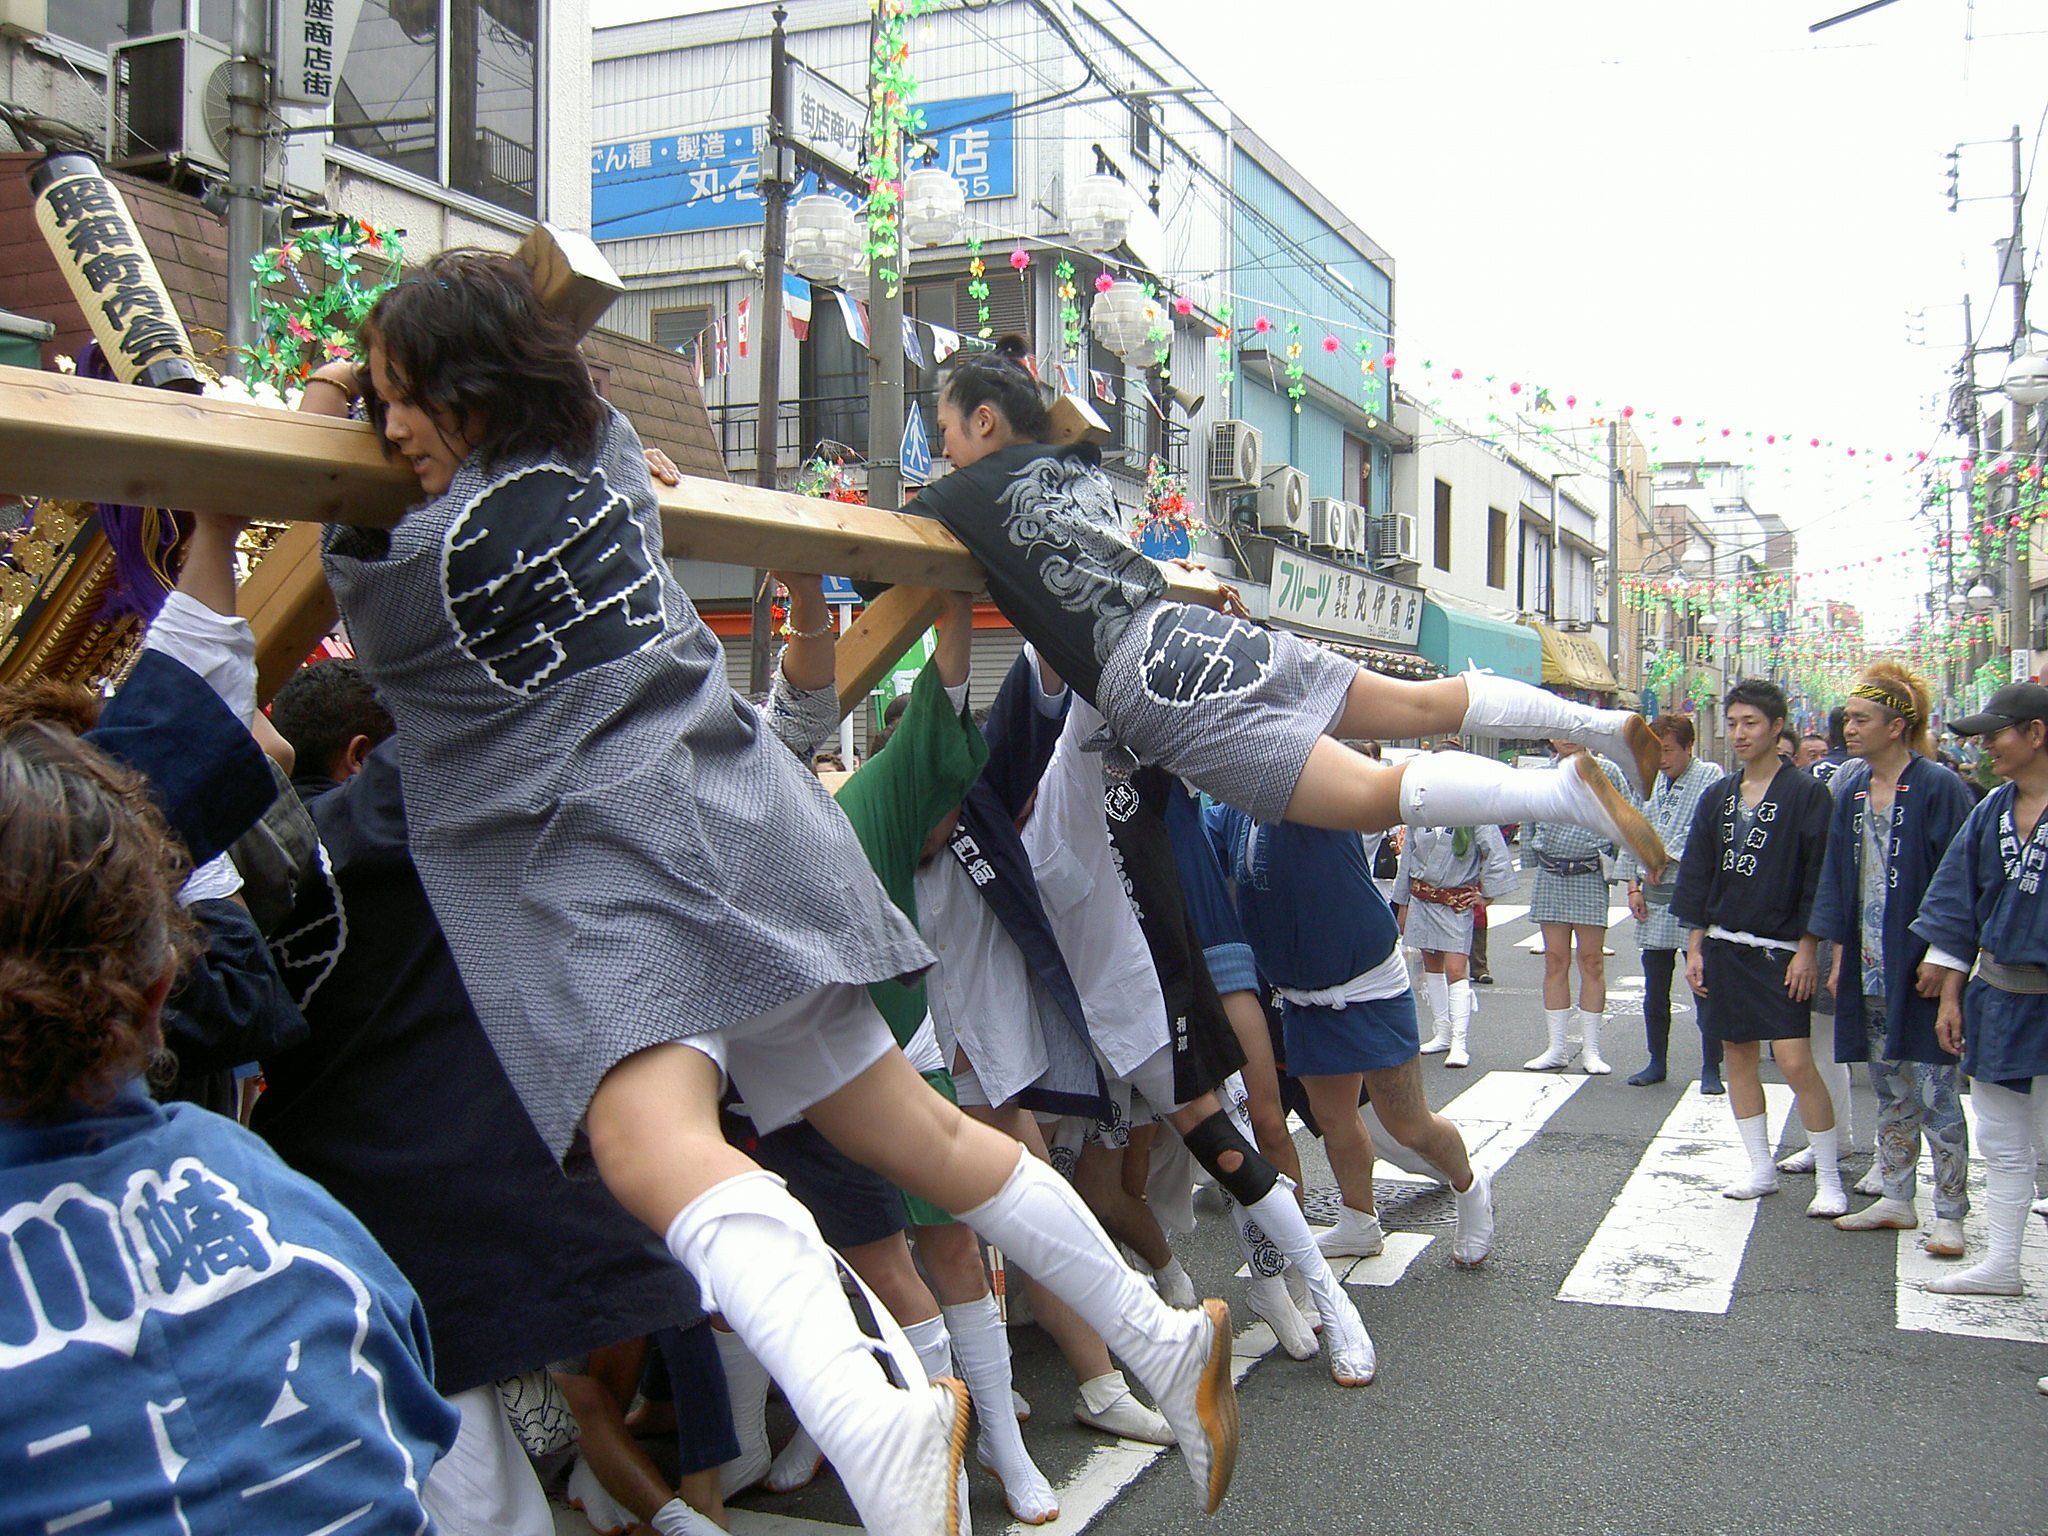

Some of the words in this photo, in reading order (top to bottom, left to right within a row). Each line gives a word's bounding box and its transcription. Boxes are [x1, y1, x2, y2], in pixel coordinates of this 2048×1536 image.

[46, 177, 182, 365] 昭和町内会
[1278, 560, 1331, 618] フルーツ
[1354, 579, 1416, 630] 丸伊商店
[0, 1158, 276, 1350] 川崎
